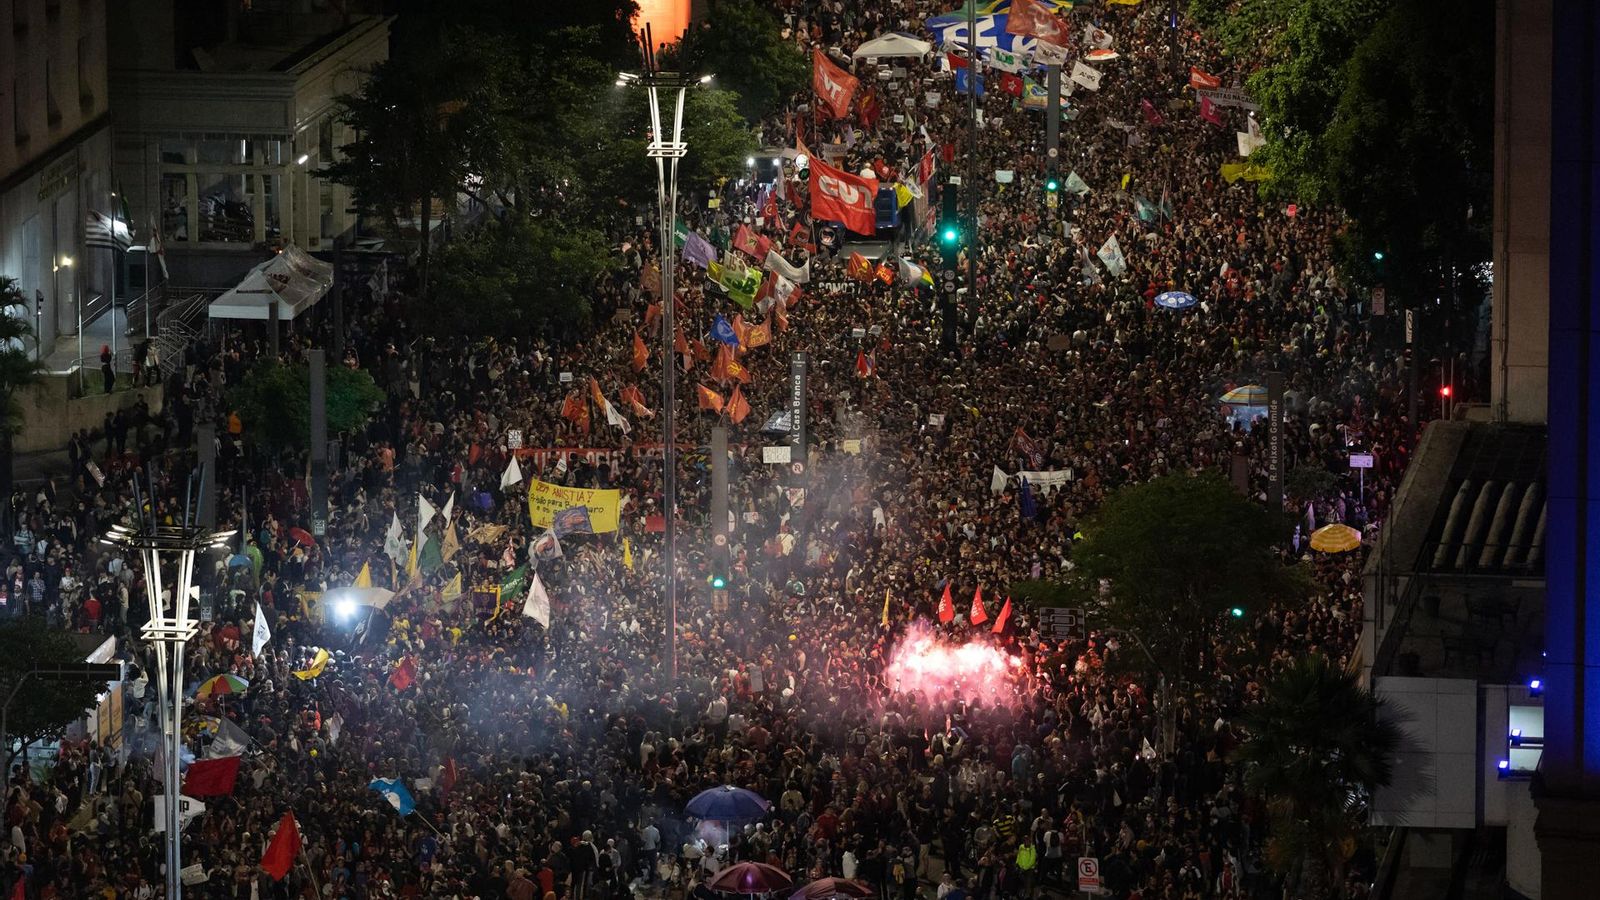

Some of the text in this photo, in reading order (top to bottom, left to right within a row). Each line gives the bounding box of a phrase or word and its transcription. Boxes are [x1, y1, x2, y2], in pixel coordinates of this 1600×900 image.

[819, 175, 873, 209] CUT
[792, 374, 801, 407] Branca
[792, 409, 801, 431] Casa
[1269, 399, 1278, 434] Gomide
[1269, 435, 1278, 471] Peixoto
